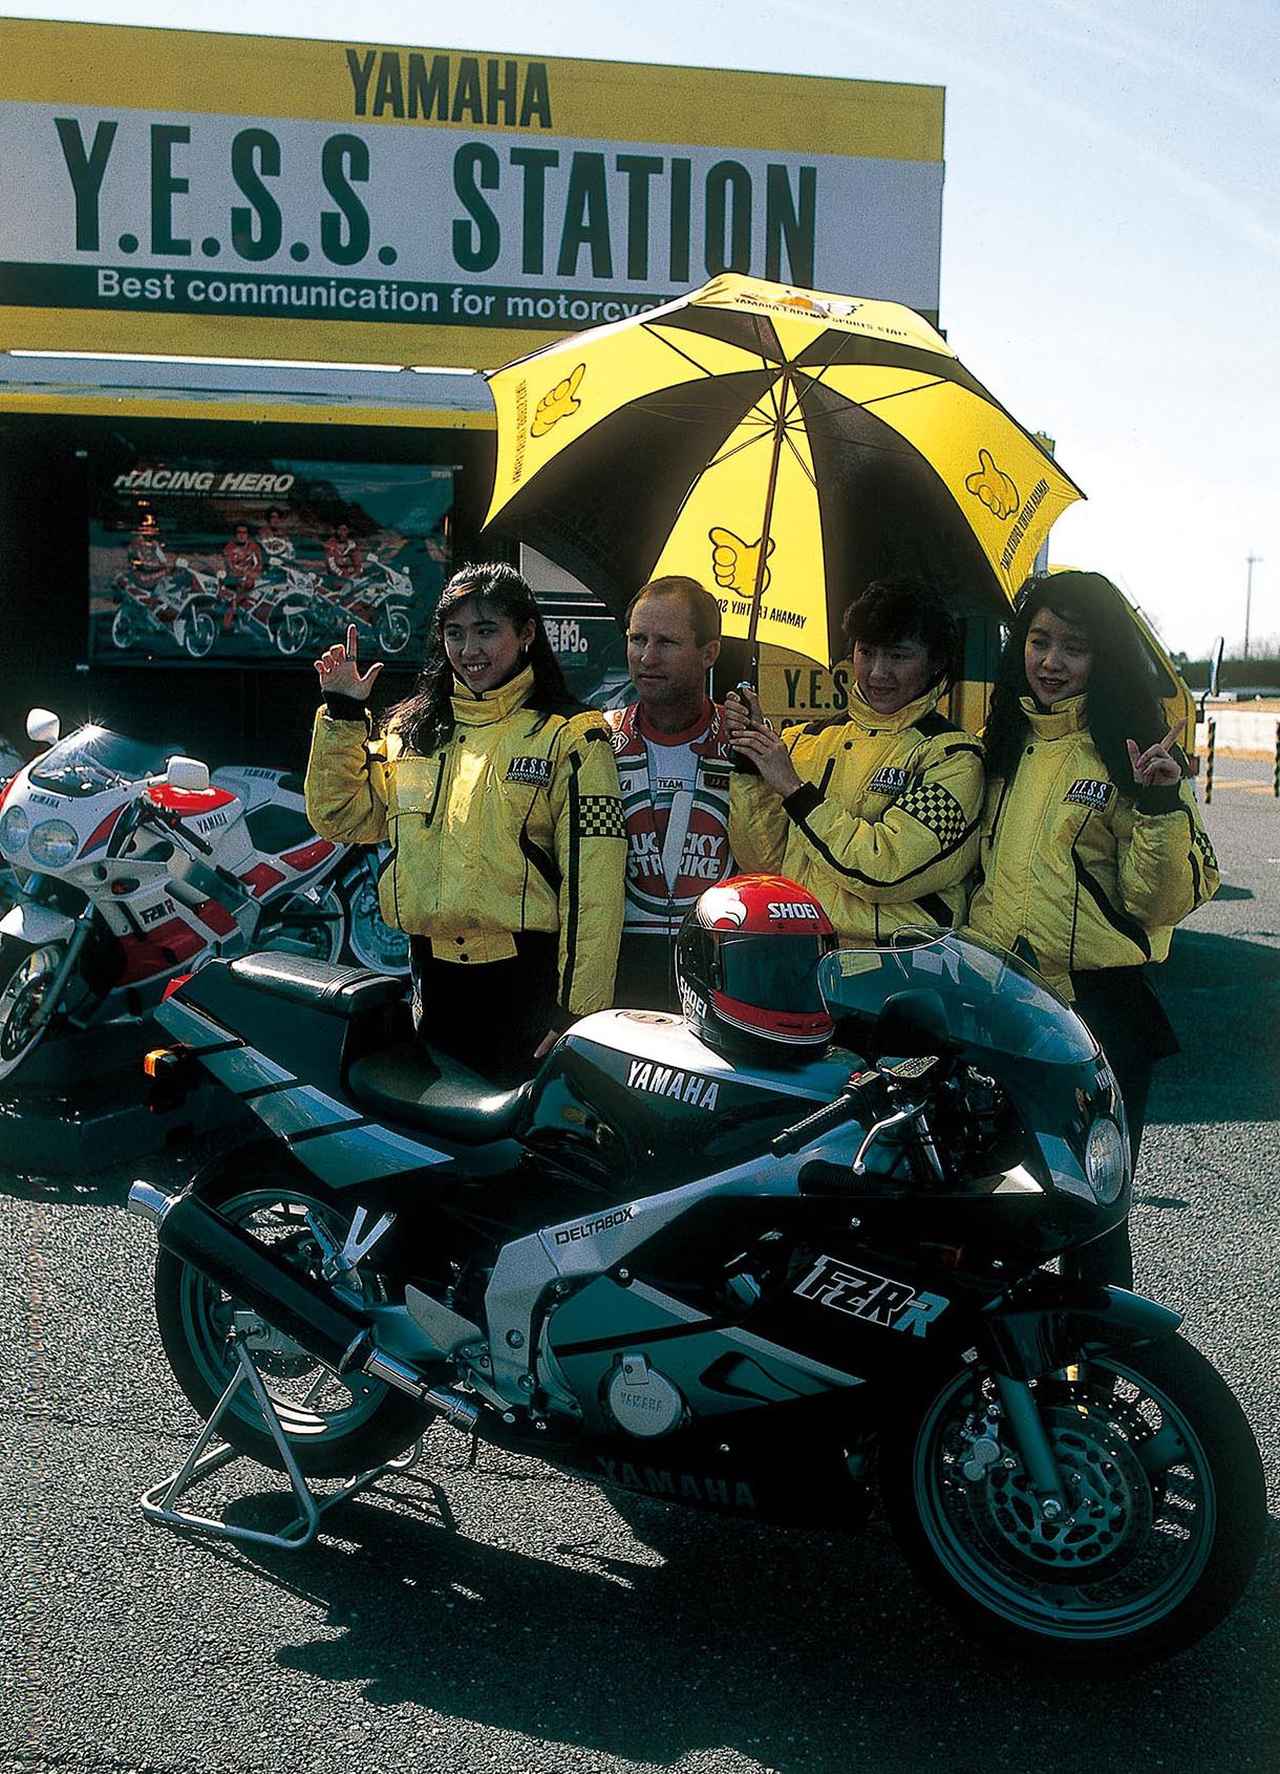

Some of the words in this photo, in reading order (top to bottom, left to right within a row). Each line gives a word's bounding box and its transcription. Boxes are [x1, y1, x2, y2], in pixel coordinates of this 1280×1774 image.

[345, 48, 552, 129] YAMAHA
[54, 117, 398, 267] Y.E.S.S.
[452, 141, 817, 288] STATION
[97, 269, 176, 300] Best
[187, 280, 439, 313] communication
[450, 288, 496, 316] for
[506, 294, 664, 321] motorcy
[219, 473, 295, 492] HERO
[658, 779, 683, 790] TEAM
[196, 812, 228, 833] YAMAHA
[767, 903, 820, 920] SHOEI
[627, 1060, 720, 1112] YAMAHA
[555, 1206, 634, 1246] DELTABOX
[595, 1456, 757, 1509] YAMAHA
